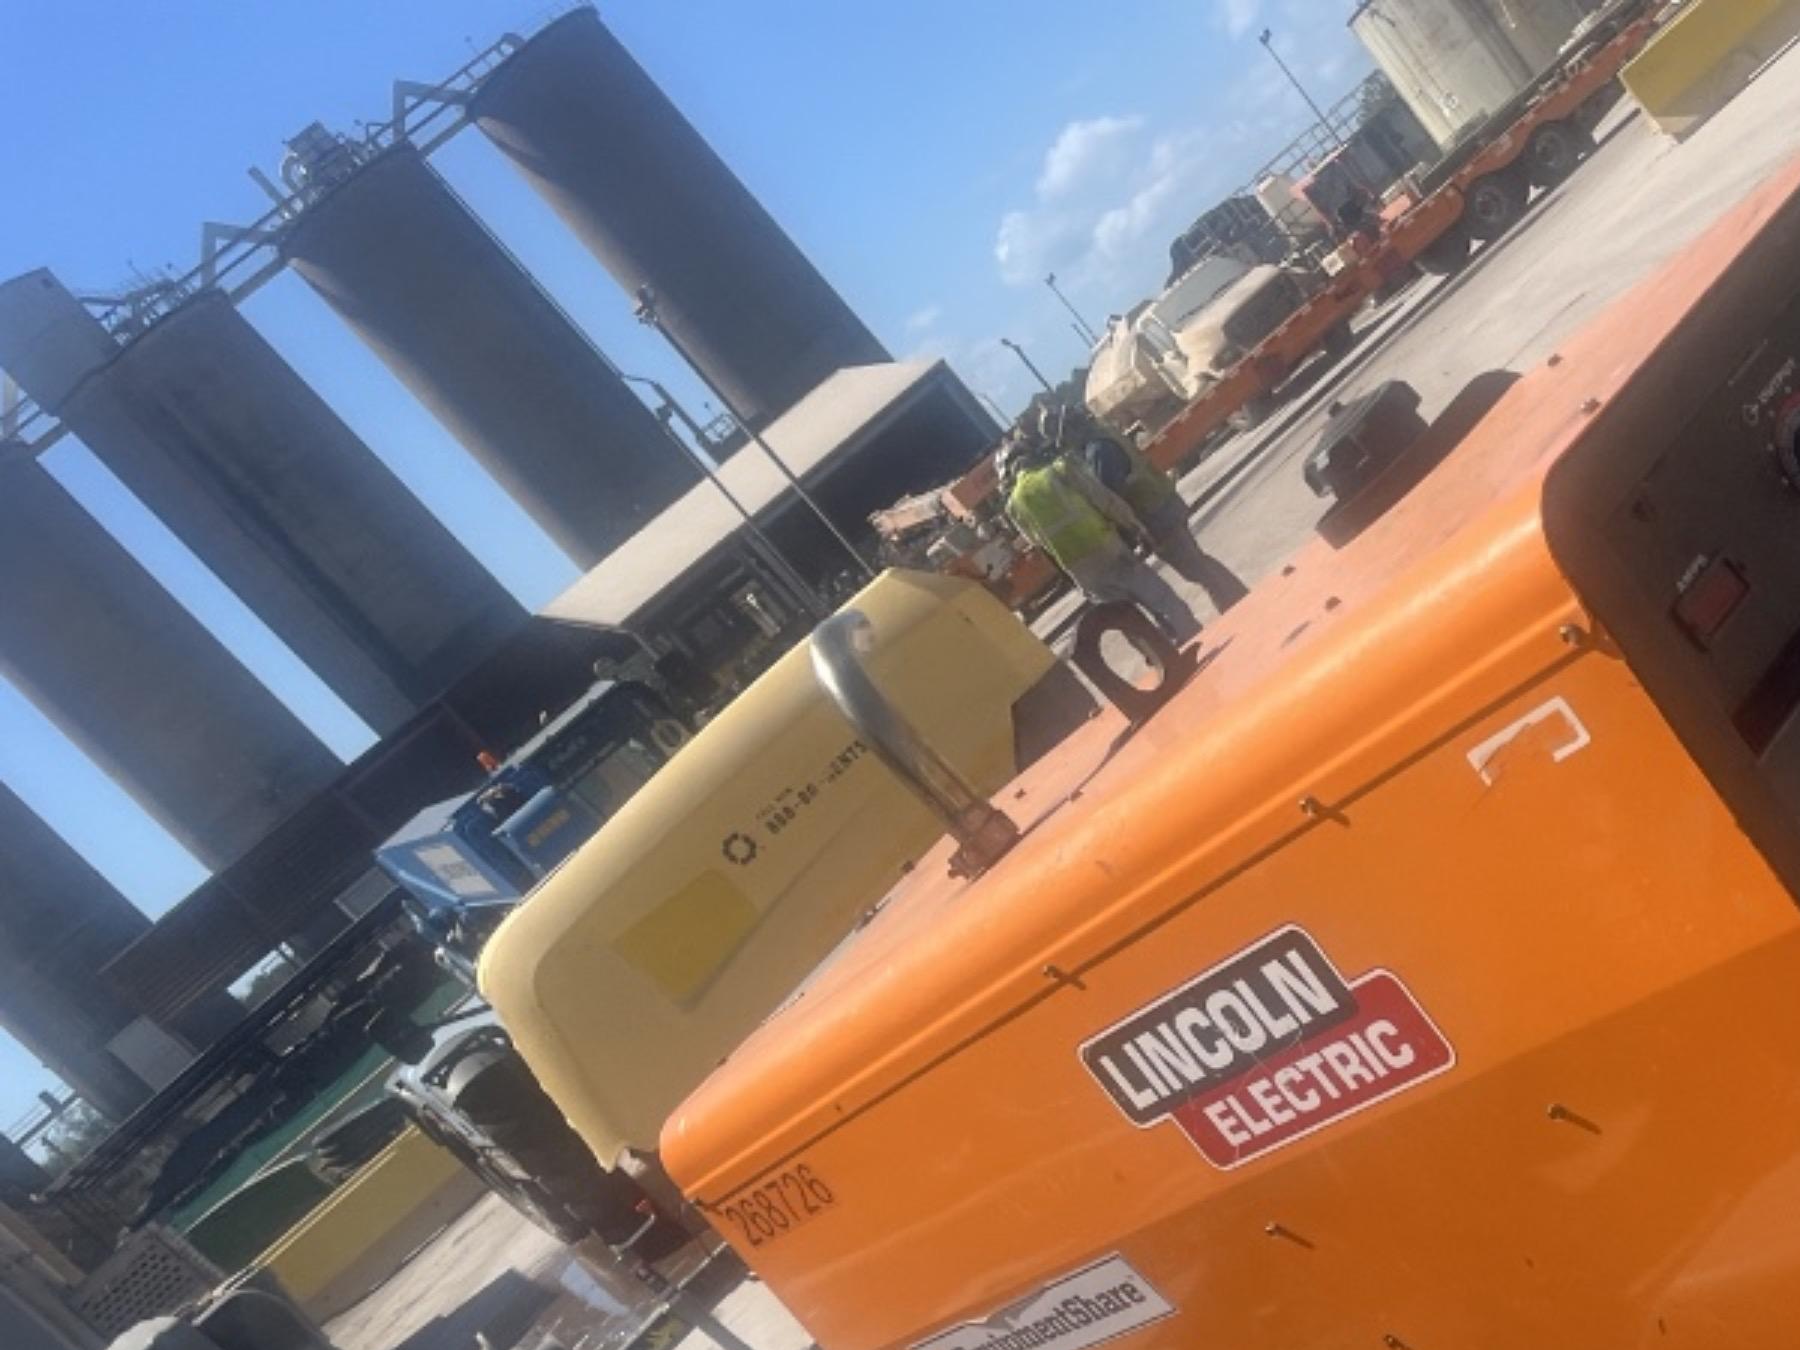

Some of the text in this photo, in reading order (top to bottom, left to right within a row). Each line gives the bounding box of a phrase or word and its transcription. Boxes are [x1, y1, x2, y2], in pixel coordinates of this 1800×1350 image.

[1098, 948, 1340, 1111] LINCOLN
[1202, 1018, 1416, 1147] ELECTRIC
[725, 1163, 834, 1247] 268726
